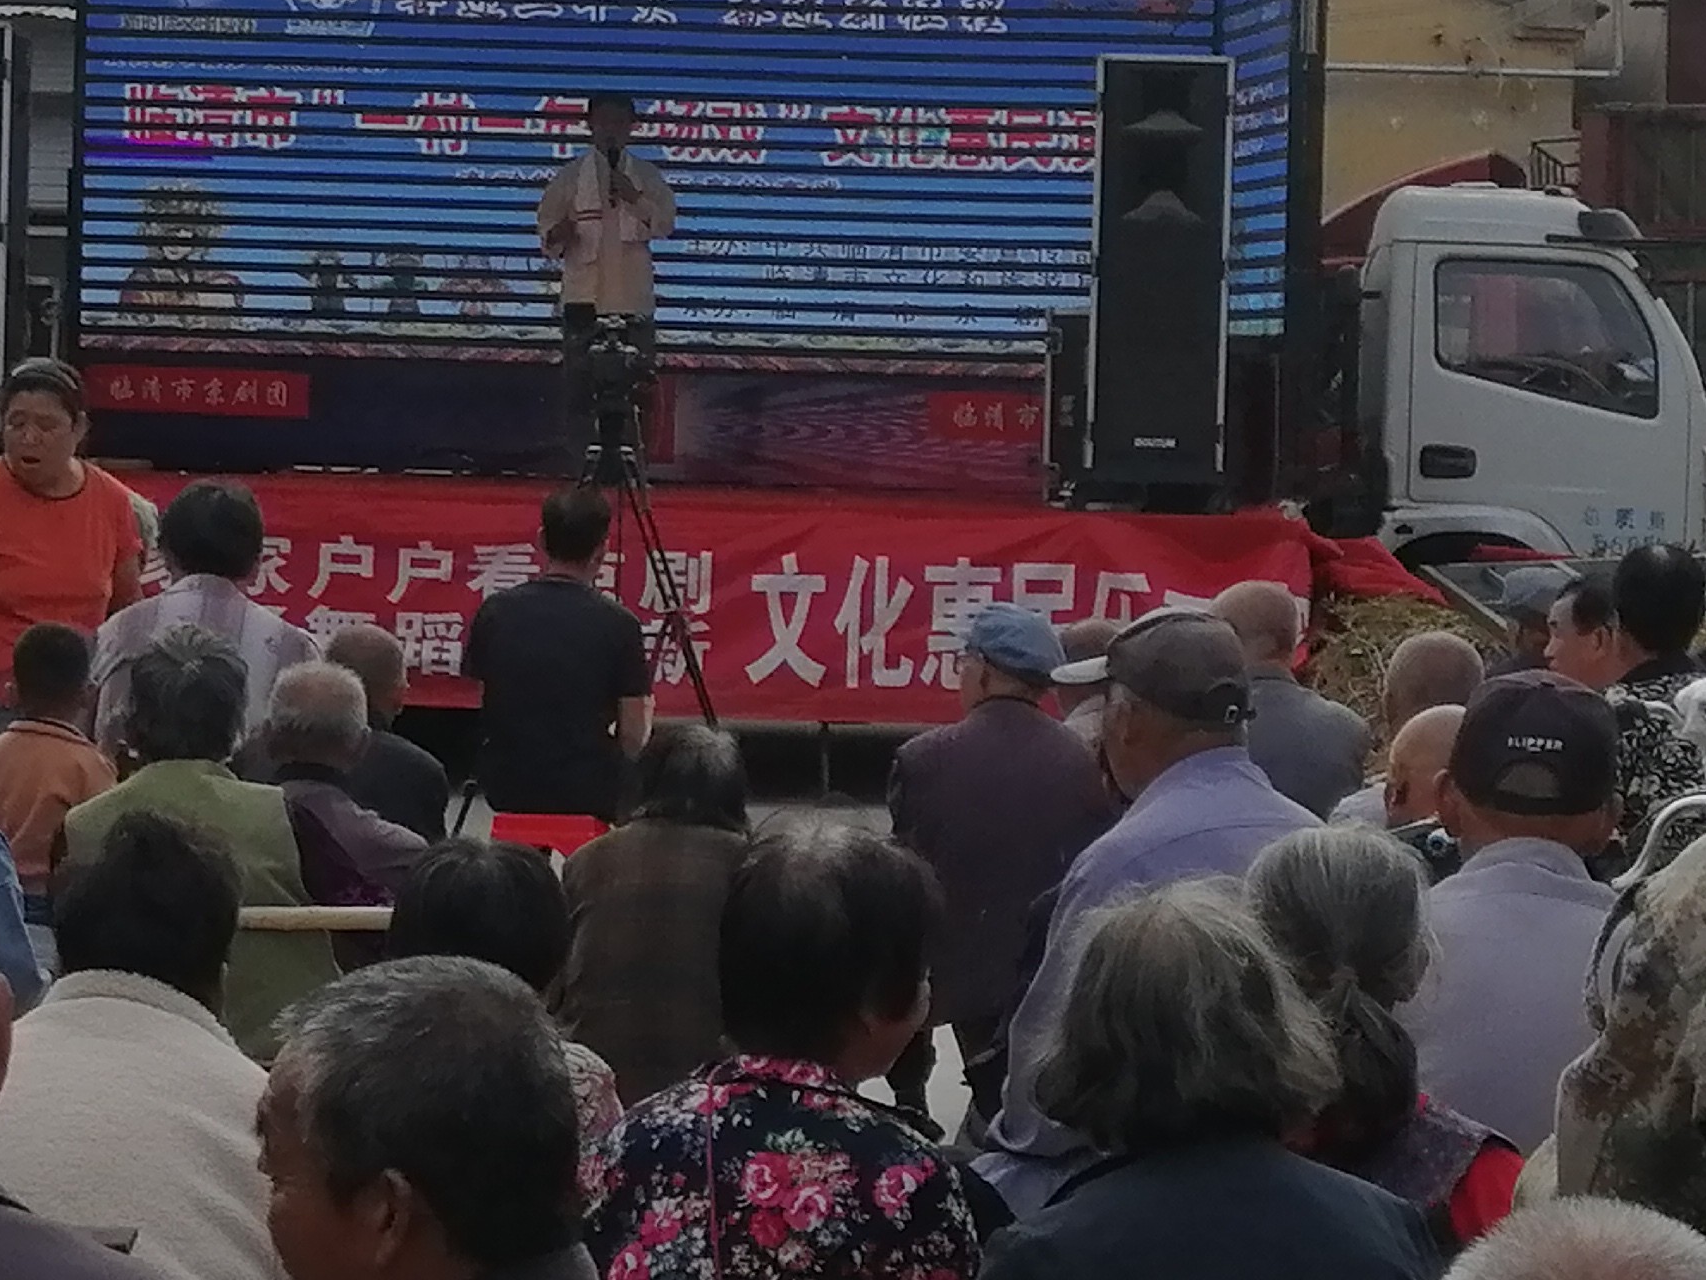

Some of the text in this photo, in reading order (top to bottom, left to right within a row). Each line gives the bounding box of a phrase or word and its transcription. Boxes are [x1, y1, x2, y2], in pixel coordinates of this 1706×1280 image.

[109, 376, 290, 408] 临清市京剧团
